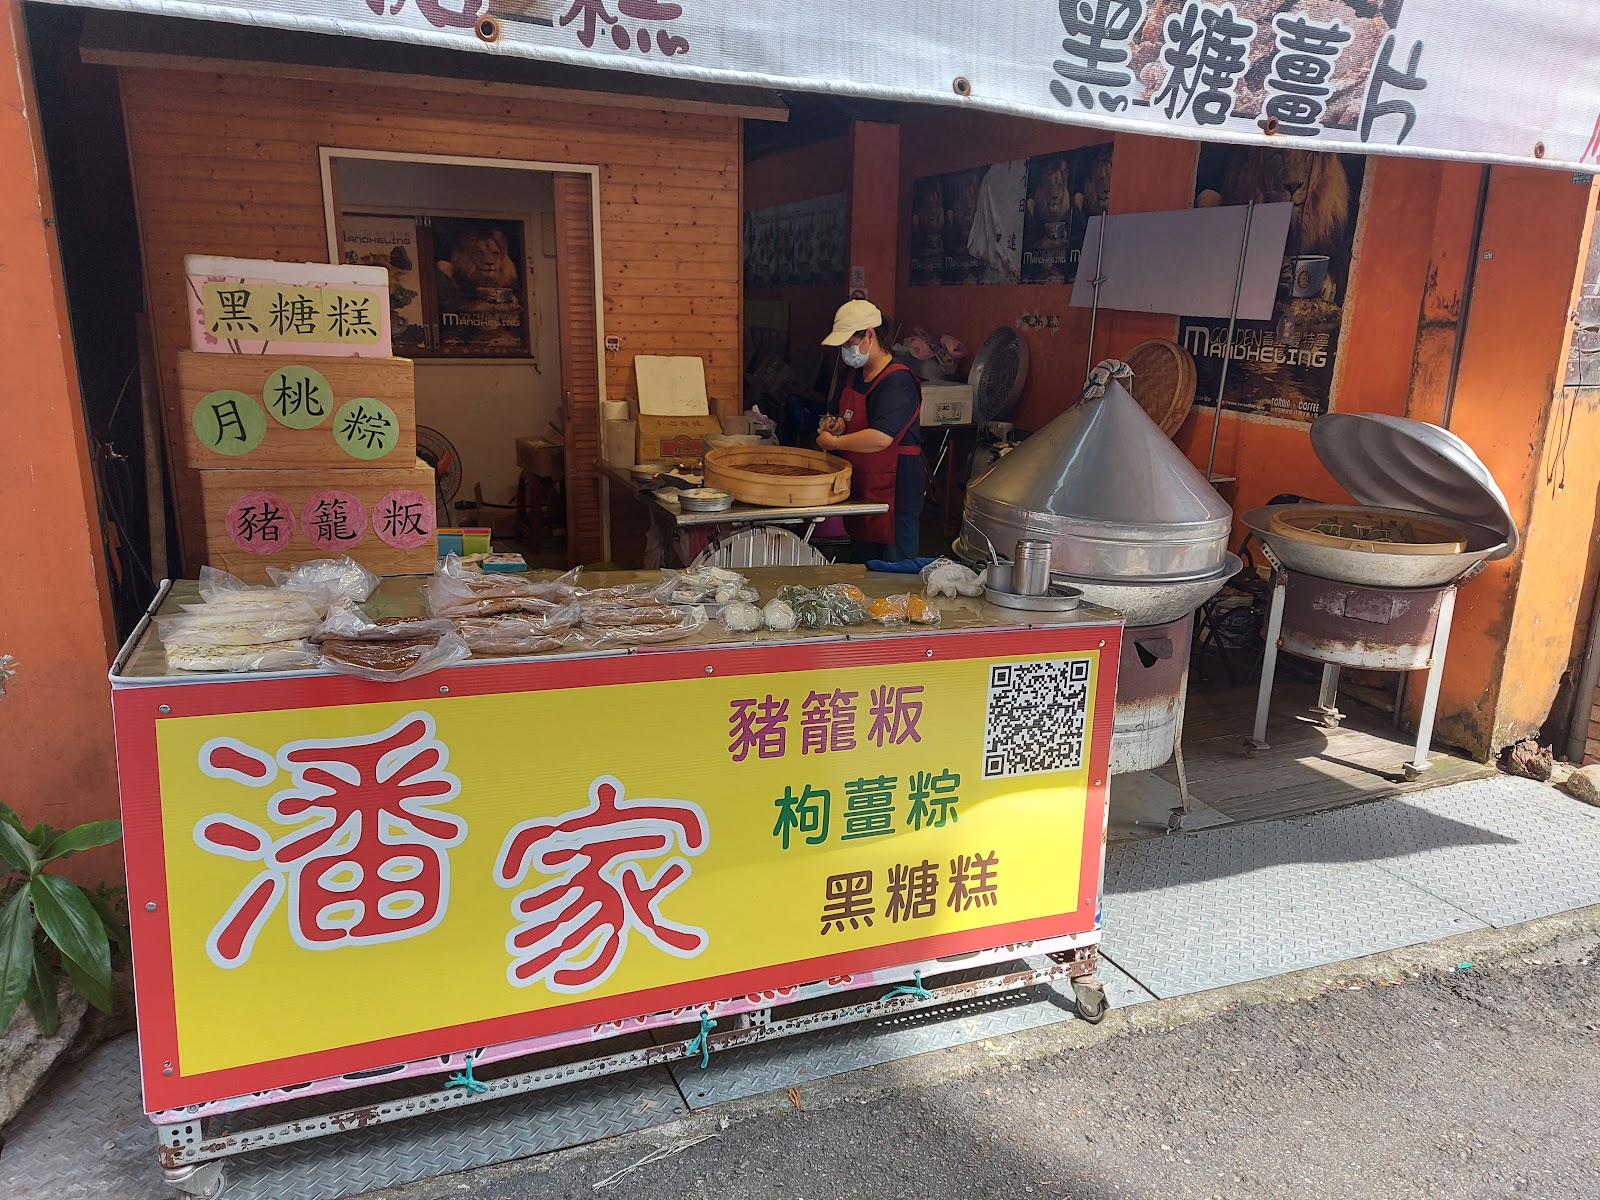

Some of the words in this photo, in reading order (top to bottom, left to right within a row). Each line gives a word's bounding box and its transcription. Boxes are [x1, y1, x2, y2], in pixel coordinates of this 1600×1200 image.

[344, 232, 411, 245] ANDHELING
[212, 289, 378, 337] 黑糖糕
[211, 374, 391, 449] 月桃粽
[236, 498, 429, 543] 豬籠粄
[727, 684, 925, 762] 豬籠粄
[772, 767, 962, 850] 枸薑粽
[193, 711, 710, 994] 潘家
[820, 849, 1000, 936] 黑糖糕
